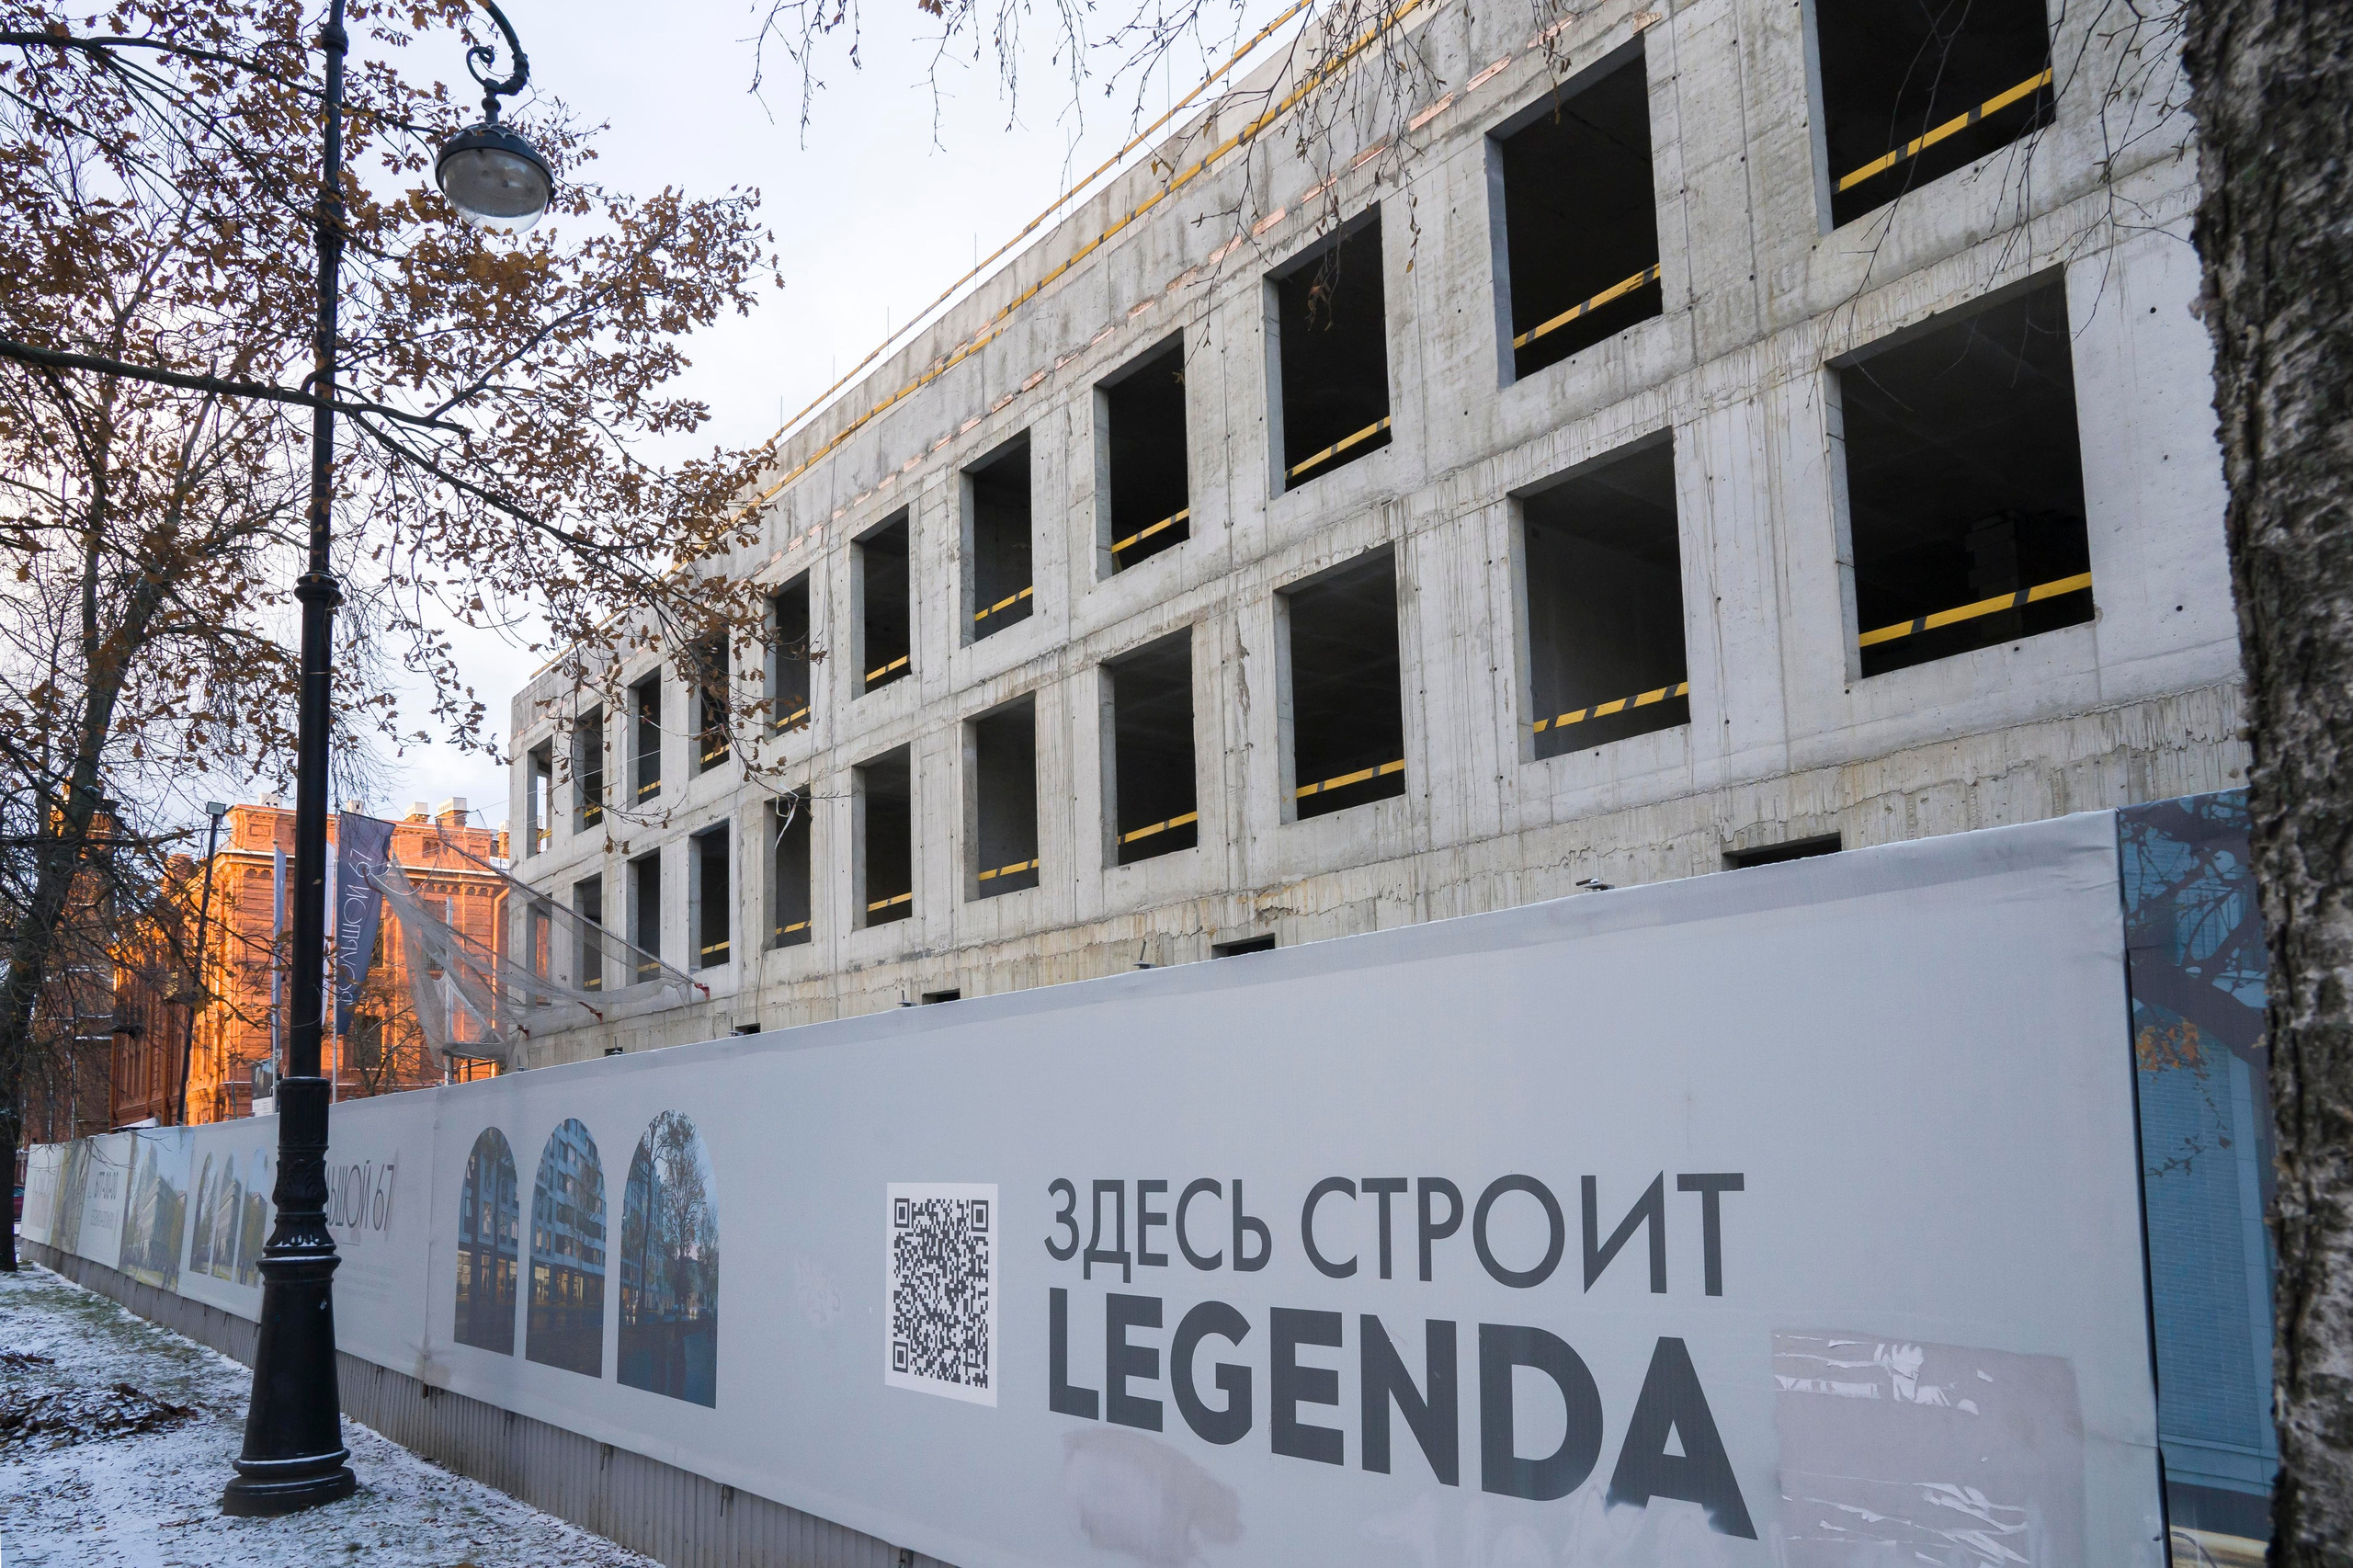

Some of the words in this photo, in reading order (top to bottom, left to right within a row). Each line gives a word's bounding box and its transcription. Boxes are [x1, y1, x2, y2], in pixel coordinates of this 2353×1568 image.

[349, 847, 373, 879] 67
[372, 1163, 395, 1232] 67
[1044, 1177, 1272, 1284] ЗДЕСЬ
[1301, 1169, 1745, 1297] СТРОИТ
[1049, 1287, 1758, 1540] LEGENDA
